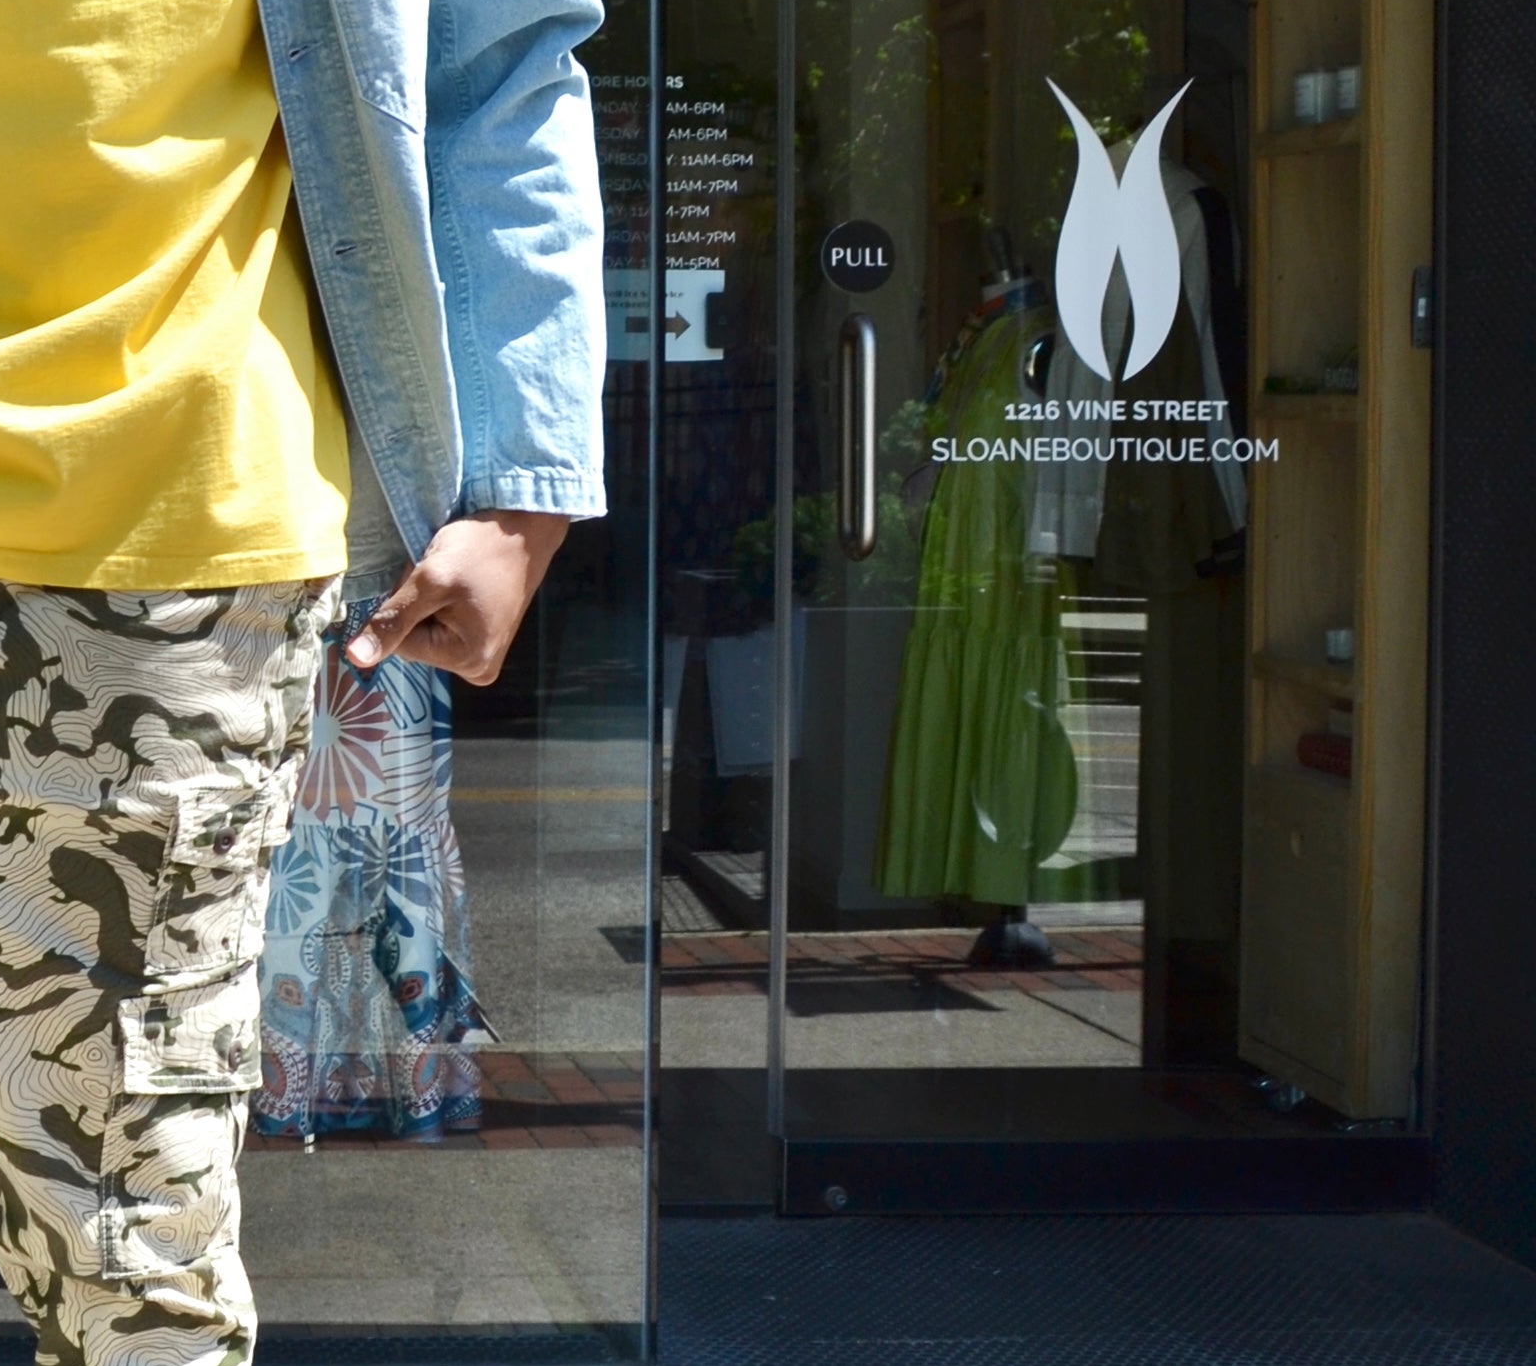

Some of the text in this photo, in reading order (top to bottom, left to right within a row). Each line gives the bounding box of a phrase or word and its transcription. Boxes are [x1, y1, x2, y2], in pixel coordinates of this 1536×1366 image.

[590, 76, 621, 88] ORE
[666, 128, 727, 141] AM-6PM
[681, 153, 754, 167] 11AM-6PM
[666, 179, 738, 193] 11AM-7PM
[665, 231, 736, 246] 11AM-7PM
[831, 247, 887, 268] PULL
[1004, 400, 1229, 422] 1216 VINE STREET
[931, 437, 1281, 463] SLOANEBOUTIQUE.COM
